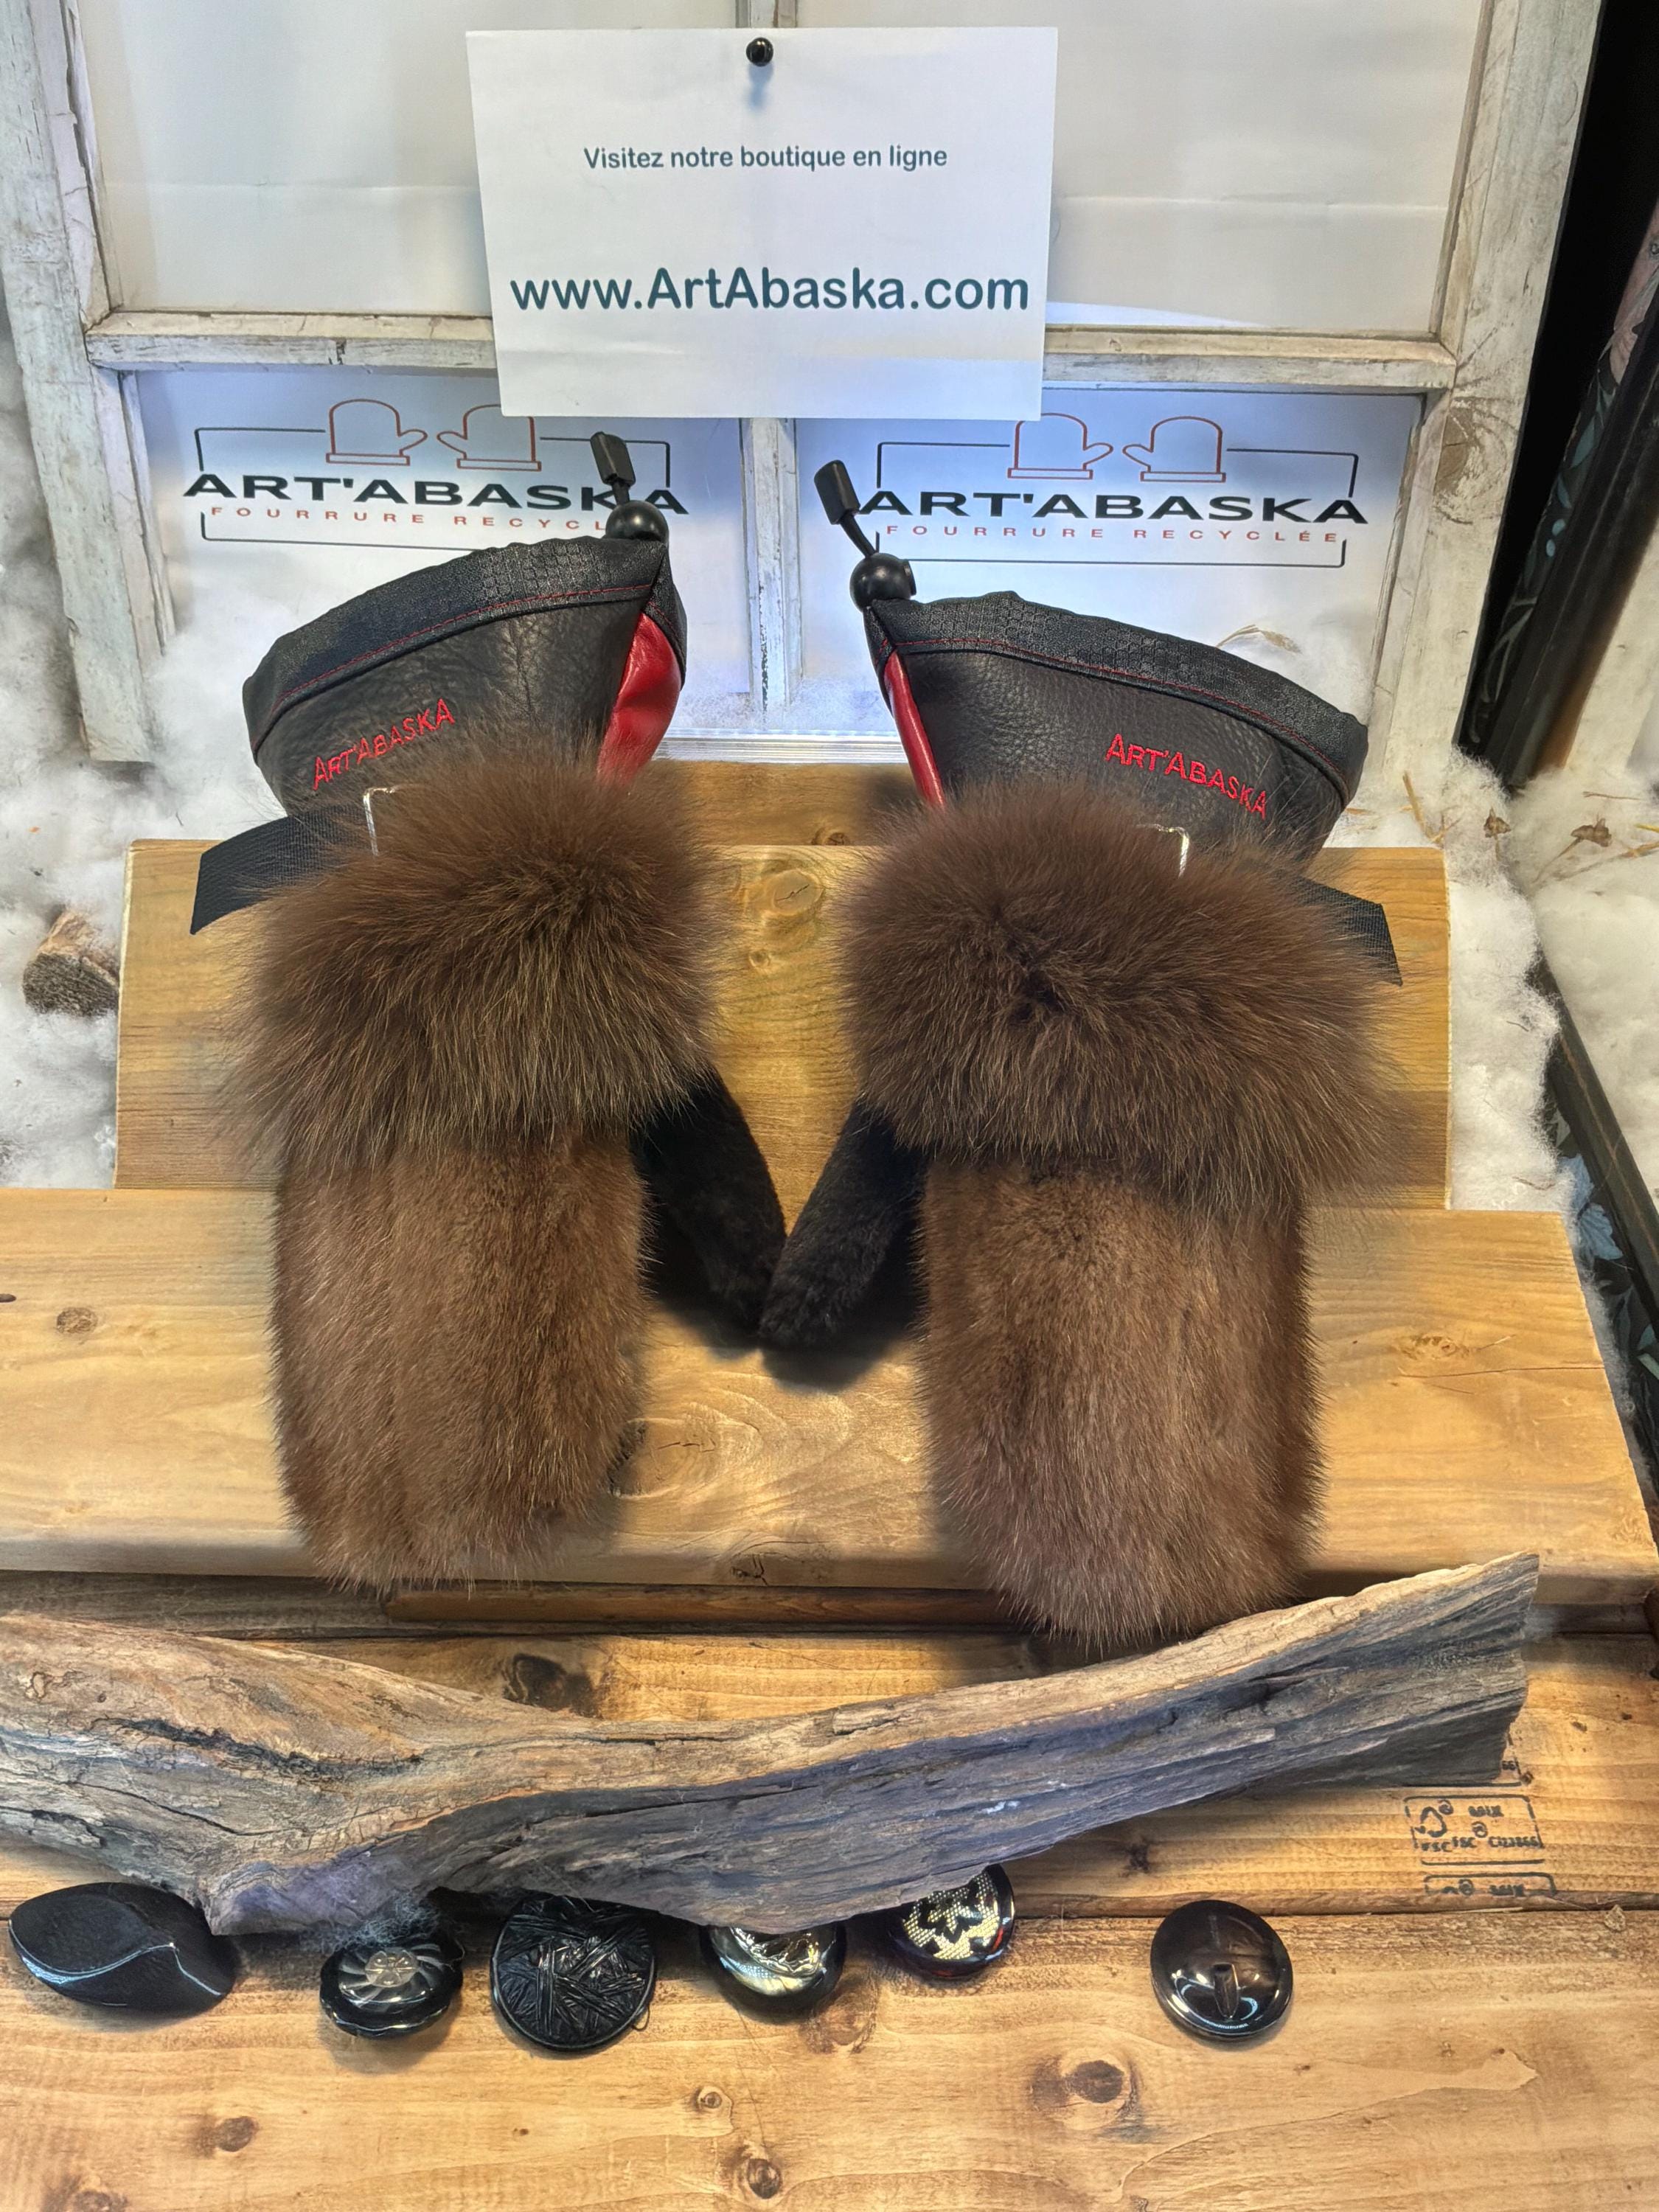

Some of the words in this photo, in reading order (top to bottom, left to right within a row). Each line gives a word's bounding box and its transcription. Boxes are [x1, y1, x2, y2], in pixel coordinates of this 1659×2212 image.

[583, 147, 664, 169] Visitez
[670, 147, 734, 167] notre
[740, 145, 846, 173] boutique
[852, 150, 882, 167] en
[889, 145, 948, 173] ligne
[509, 266, 1029, 310] www.ArtAbaska.com
[183, 473, 689, 515] ART'ABASKA
[859, 490, 1368, 524] ART'ABASKA
[211, 507, 424, 525] FOURRURE
[453, 515, 606, 531] RECYCL
[886, 524, 1104, 539] FOURRURE
[1133, 529, 1337, 543] RECYCLÉE
[1105, 733, 1267, 821] ART'ABASKA
